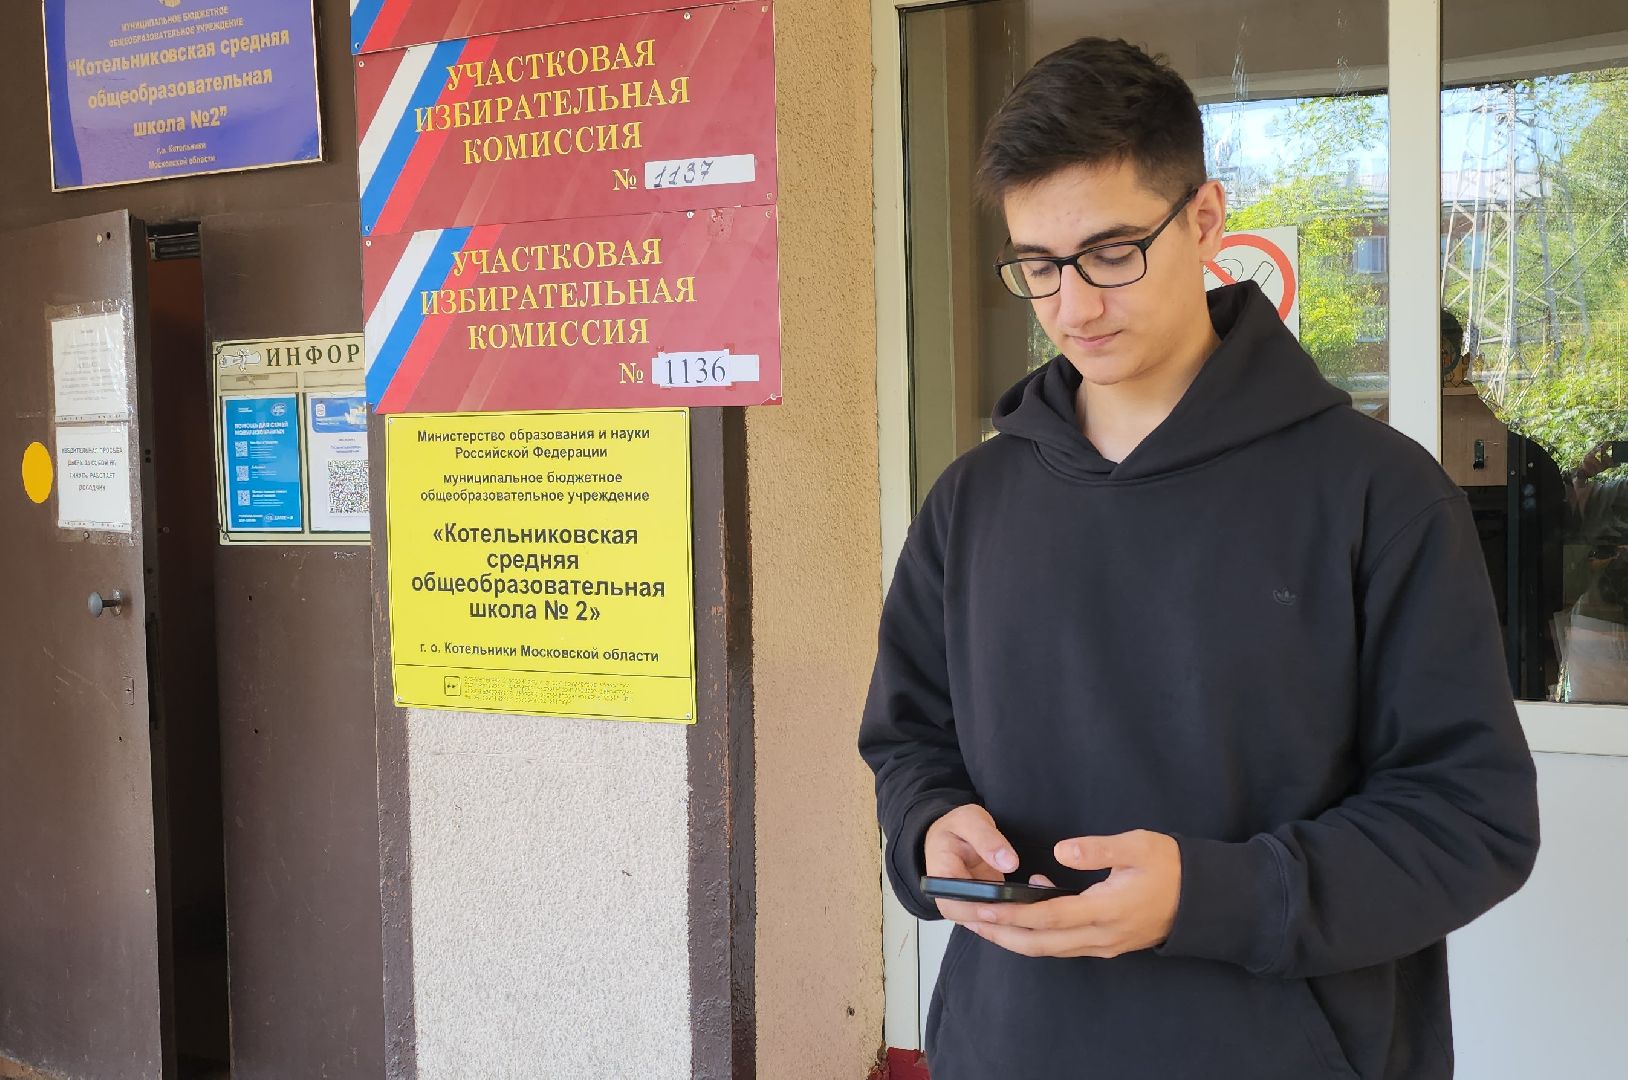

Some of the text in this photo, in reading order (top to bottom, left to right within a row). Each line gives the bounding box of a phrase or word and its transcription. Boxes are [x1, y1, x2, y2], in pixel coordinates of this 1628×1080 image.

[121, 6, 229, 32] МУНИЦИПАЛЬНОЕ БЮДЖЕТНОЕ
[109, 17, 244, 48] ОБЩЕОБРАЗОВАТЕЛЬНОЕ УЧРЕЖДЕНИЕ
[220, 29, 290, 58] средняя
[446, 38, 655, 91] УЧАСТКОВАЯ
[87, 67, 273, 109] общеобразовательная
[414, 76, 690, 133] ИЗБИРАТЕЛЬНАЯ
[133, 115, 186, 138] школа
[462, 121, 643, 165] КОМИССИЯ
[148, 154, 216, 169] Московской области
[653, 159, 714, 188] 1137
[612, 168, 638, 191] №
[451, 238, 663, 277] УЧАСТКОВАЯ
[420, 276, 697, 316] ИЗБИРАТЕЛЬНАЯ
[468, 318, 649, 351] КОМИССИЯ
[618, 354, 727, 385] № 1136
[418, 429, 650, 444] Министерство образования и науки
[455, 446, 607, 460] Российской Федерации
[443, 471, 623, 485] муниципальное бюджетное
[420, 489, 650, 504] общеобразовательное учреждение
[433, 522, 638, 544] «Котельниковская
[487, 553, 579, 572] средняя
[412, 572, 665, 598] общеобразовательная
[469, 600, 601, 621] школа № 2»
[444, 642, 517, 657] Котельники
[520, 645, 599, 660] Московской
[603, 649, 659, 662] области
